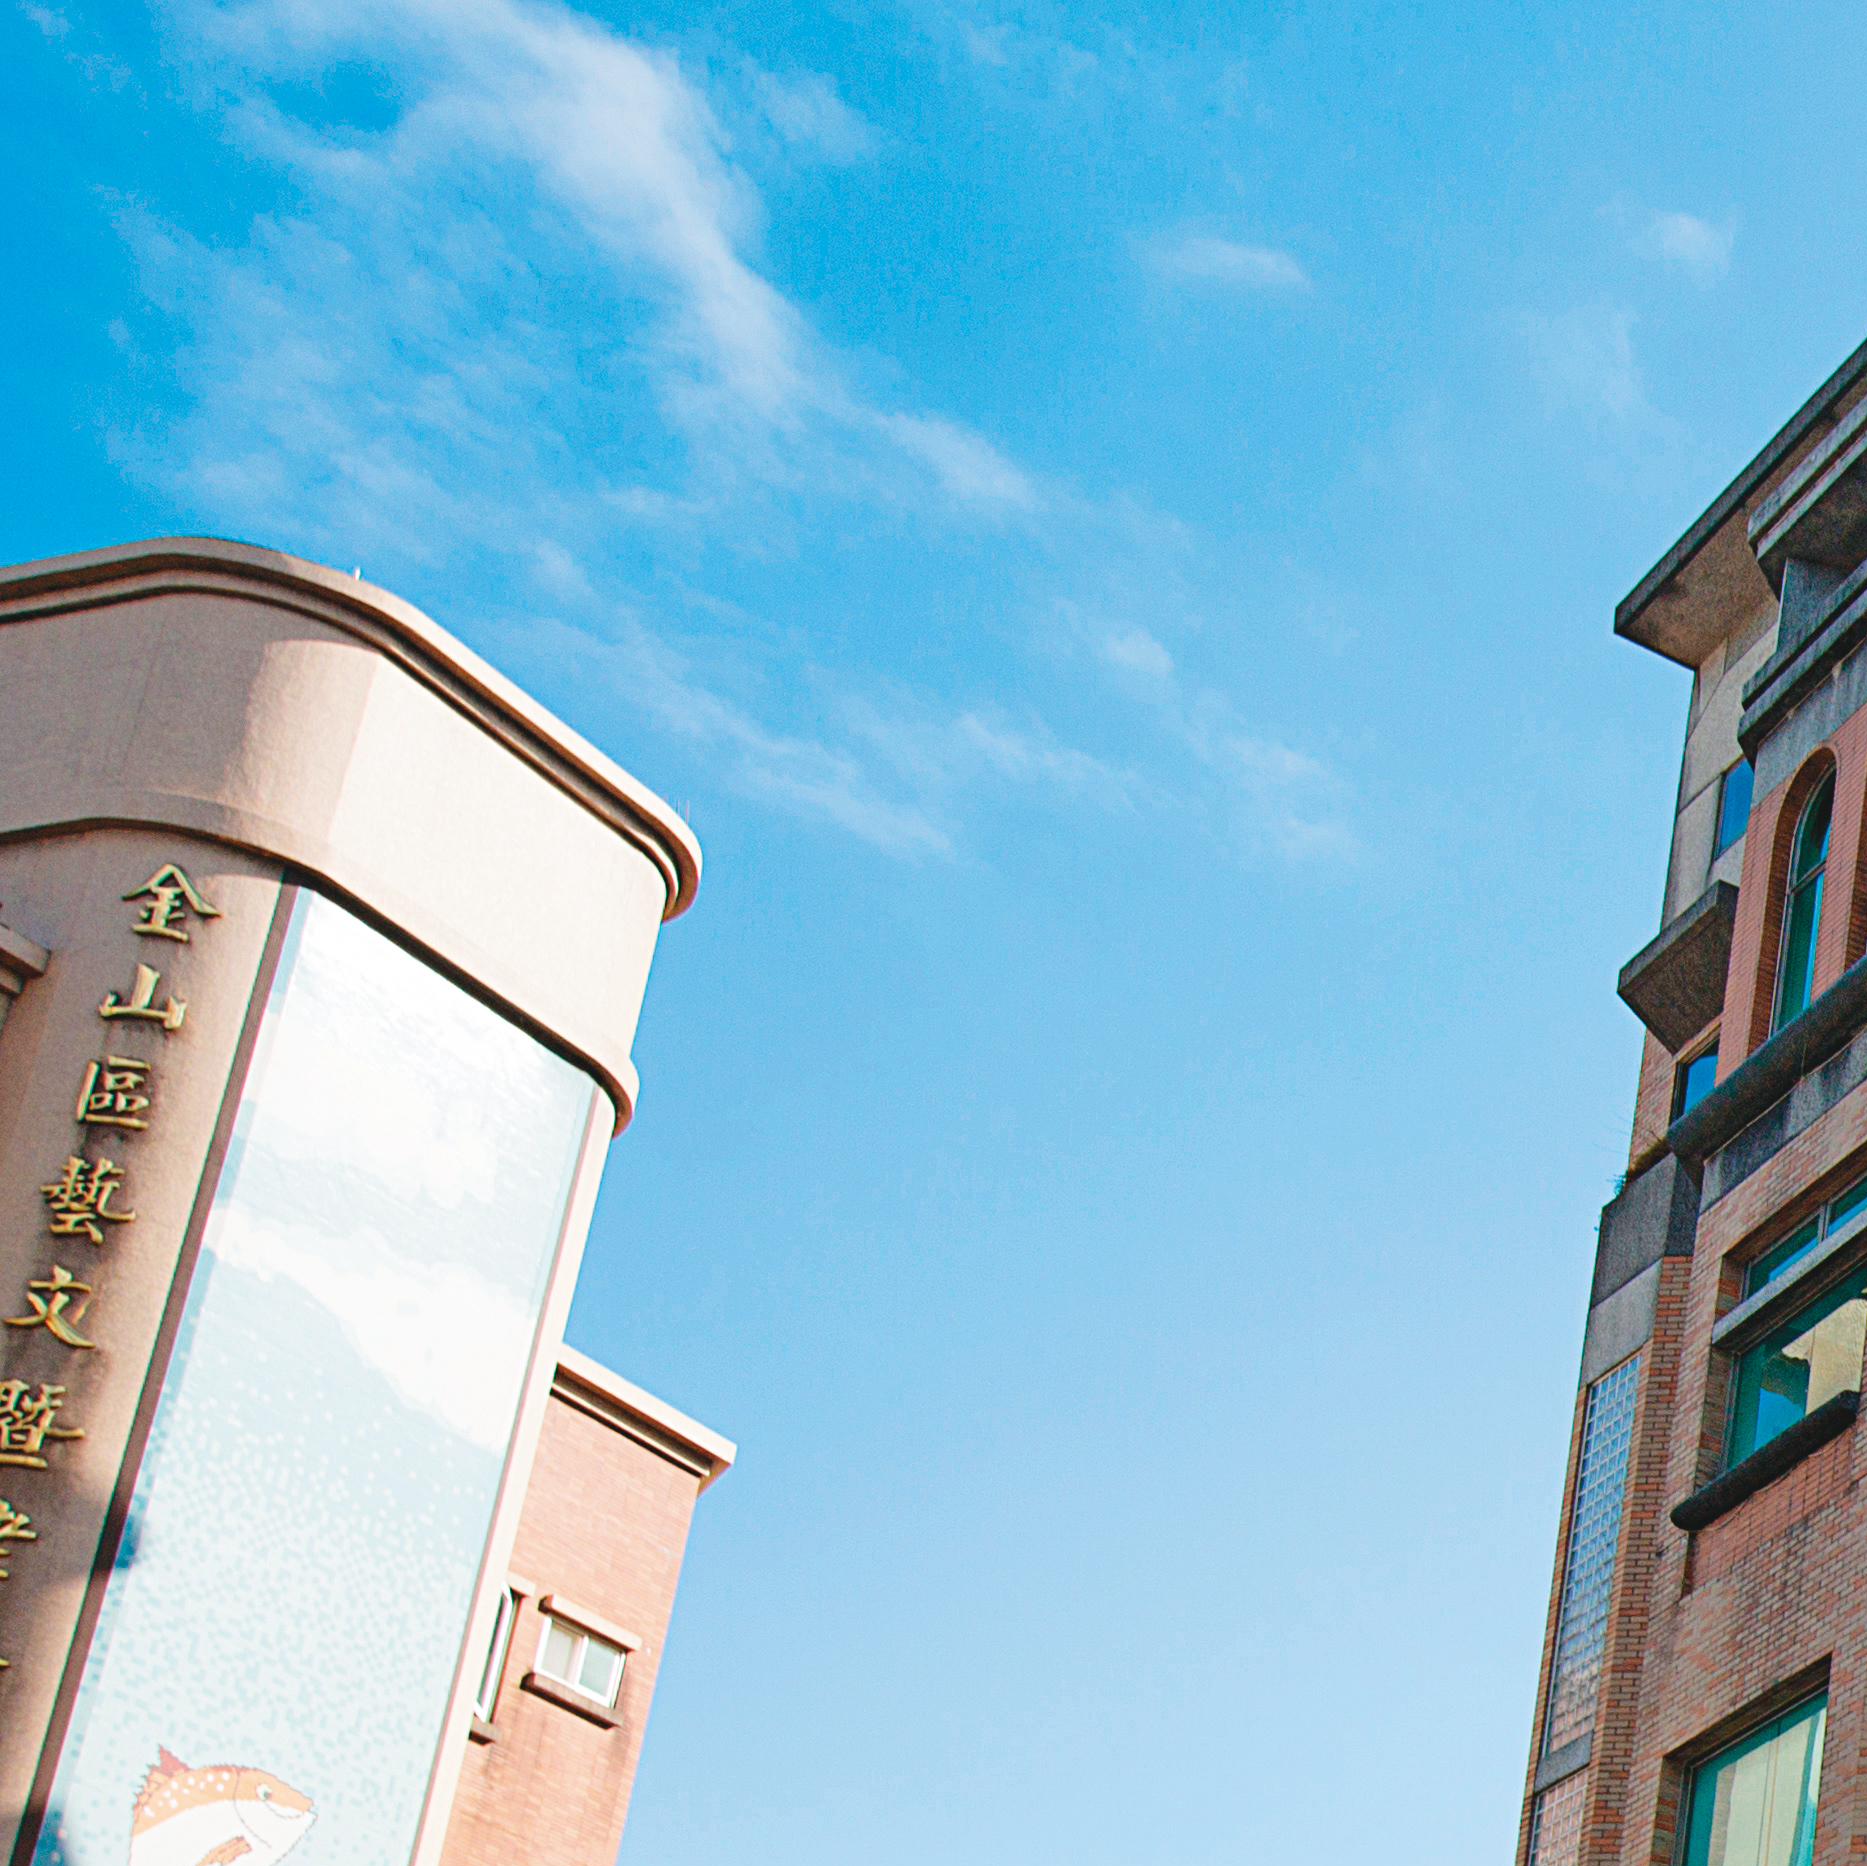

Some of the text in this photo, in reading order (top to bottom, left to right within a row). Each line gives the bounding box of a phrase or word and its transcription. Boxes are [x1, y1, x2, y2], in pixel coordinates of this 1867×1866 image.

[0, 863, 221, 1672] 金山區藝文暨
